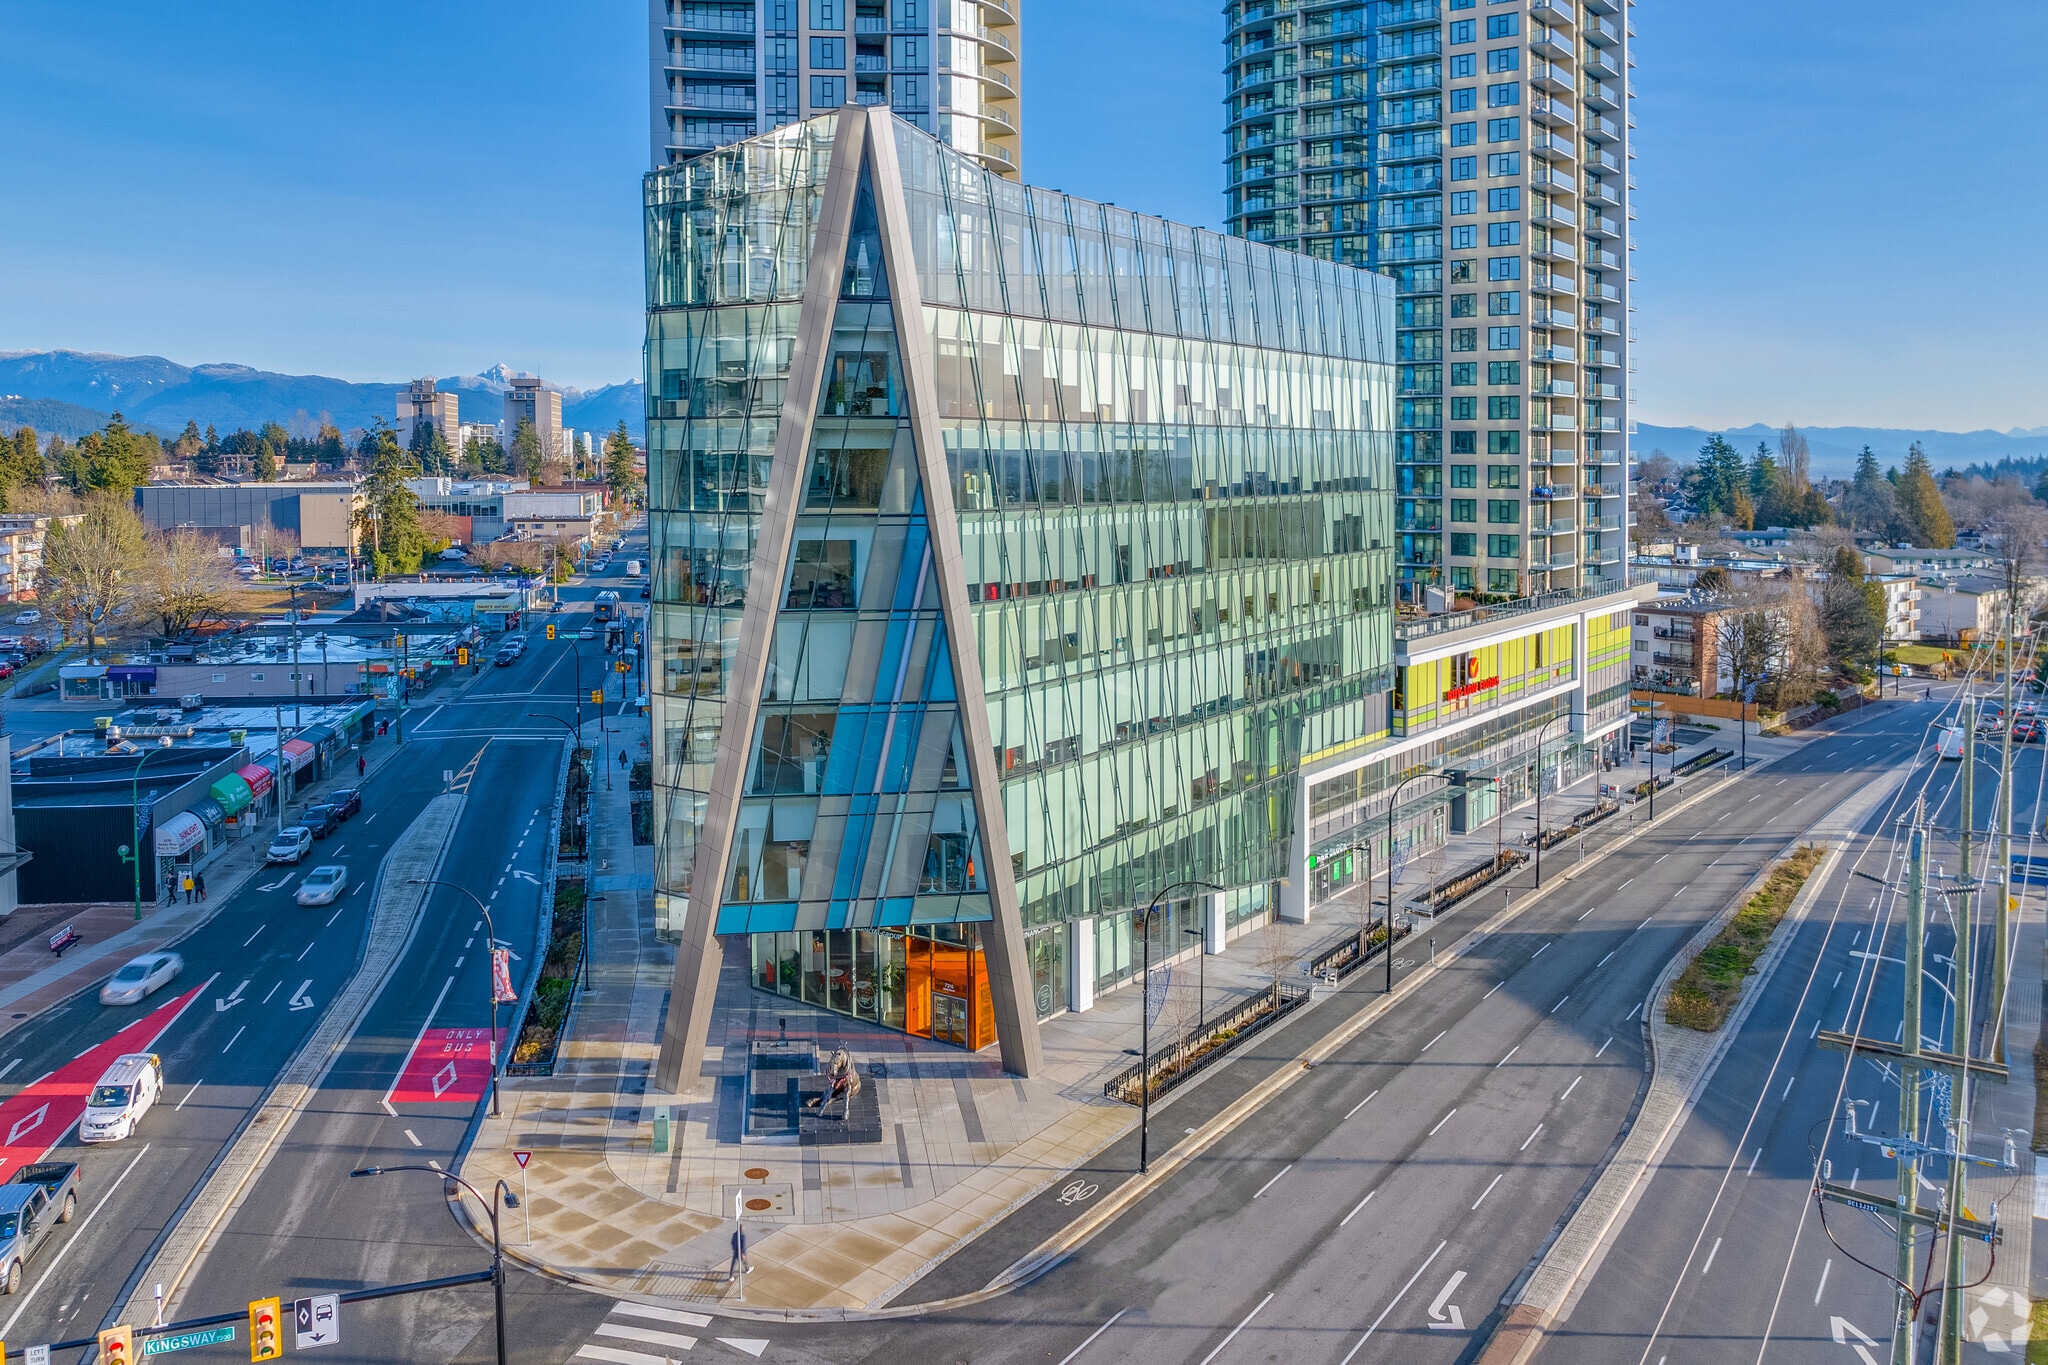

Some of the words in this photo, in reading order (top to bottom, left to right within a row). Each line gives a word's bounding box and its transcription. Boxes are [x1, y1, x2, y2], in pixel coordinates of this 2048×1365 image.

[1446, 682, 1479, 702] BUY-LOW
[1479, 675, 1500, 691] FOODS
[179, 823, 199, 840] SUNLIGHT
[446, 1030, 482, 1039] ONLY
[443, 1042, 473, 1052] BUS
[147, 1331, 216, 1354] KINGSWAY
[216, 1334, 232, 1342] 7300
[30, 1348, 44, 1356] LEFT
